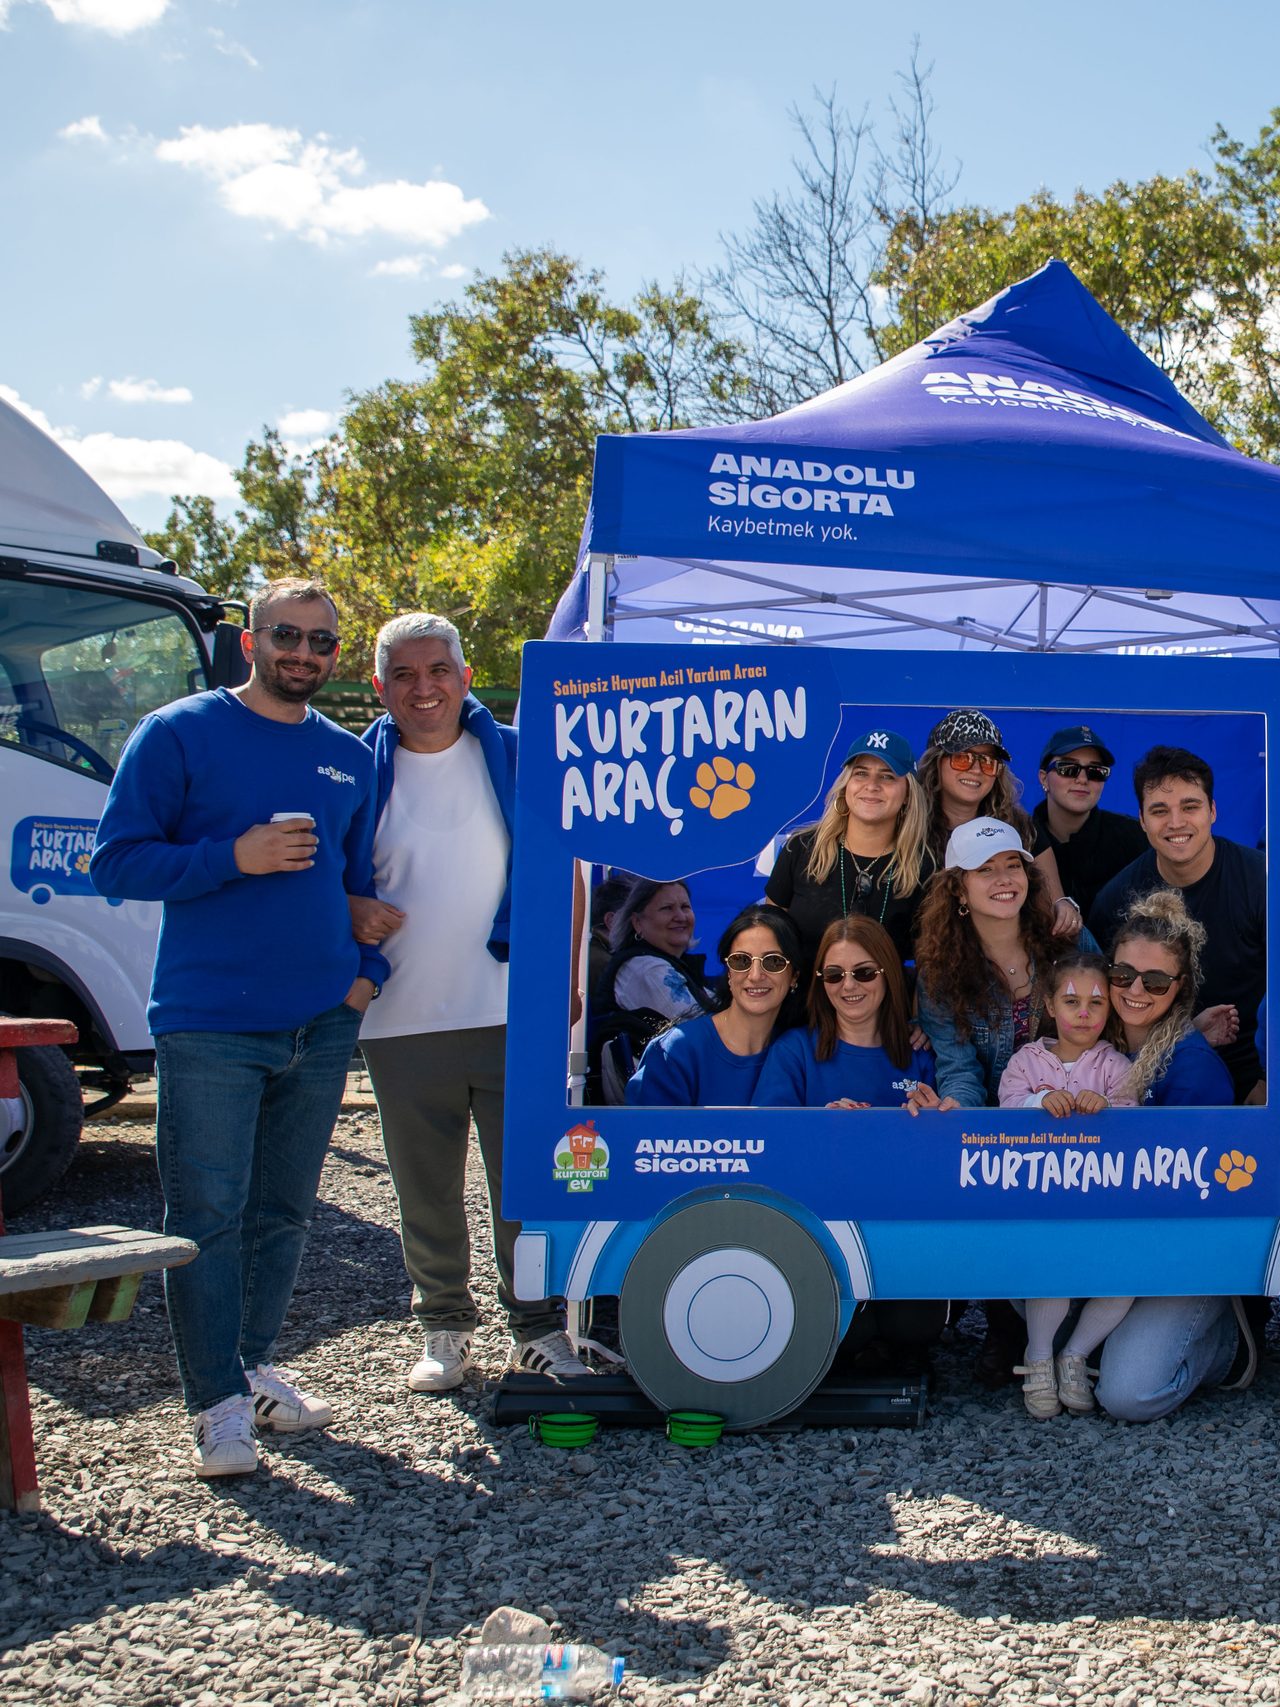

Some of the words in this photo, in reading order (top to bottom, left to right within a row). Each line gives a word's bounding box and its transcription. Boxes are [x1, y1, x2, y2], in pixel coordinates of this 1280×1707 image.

[709, 452, 915, 489] ANADOLU
[708, 476, 895, 517] SİGORTA
[708, 515, 814, 537] Kaybetmek
[820, 524, 858, 542] yok.
[553, 678, 609, 699] Sahipsiz
[612, 674, 657, 694] Hayvan
[660, 669, 684, 687] Acil
[686, 666, 731, 684] Yardım
[734, 663, 767, 680] Aracı
[556, 686, 807, 762] KURTARAN
[562, 755, 684, 836] ARAÇ
[31, 828, 96, 853] KURTAR
[29, 849, 73, 877] ARAÇ
[635, 1138, 765, 1154] ANADOLU
[961, 1132, 997, 1147] Sahipsiz
[999, 1133, 1029, 1147] Hayvan
[1031, 1132, 1047, 1144] Acil
[1048, 1132, 1077, 1144] Yardım
[1079, 1132, 1101, 1144] Aracı
[634, 1154, 750, 1173] SİGORTA
[960, 1148, 1124, 1193] KURTARAN
[1132, 1145, 1210, 1200] ARAÇ
[570, 1179, 591, 1191] ev
